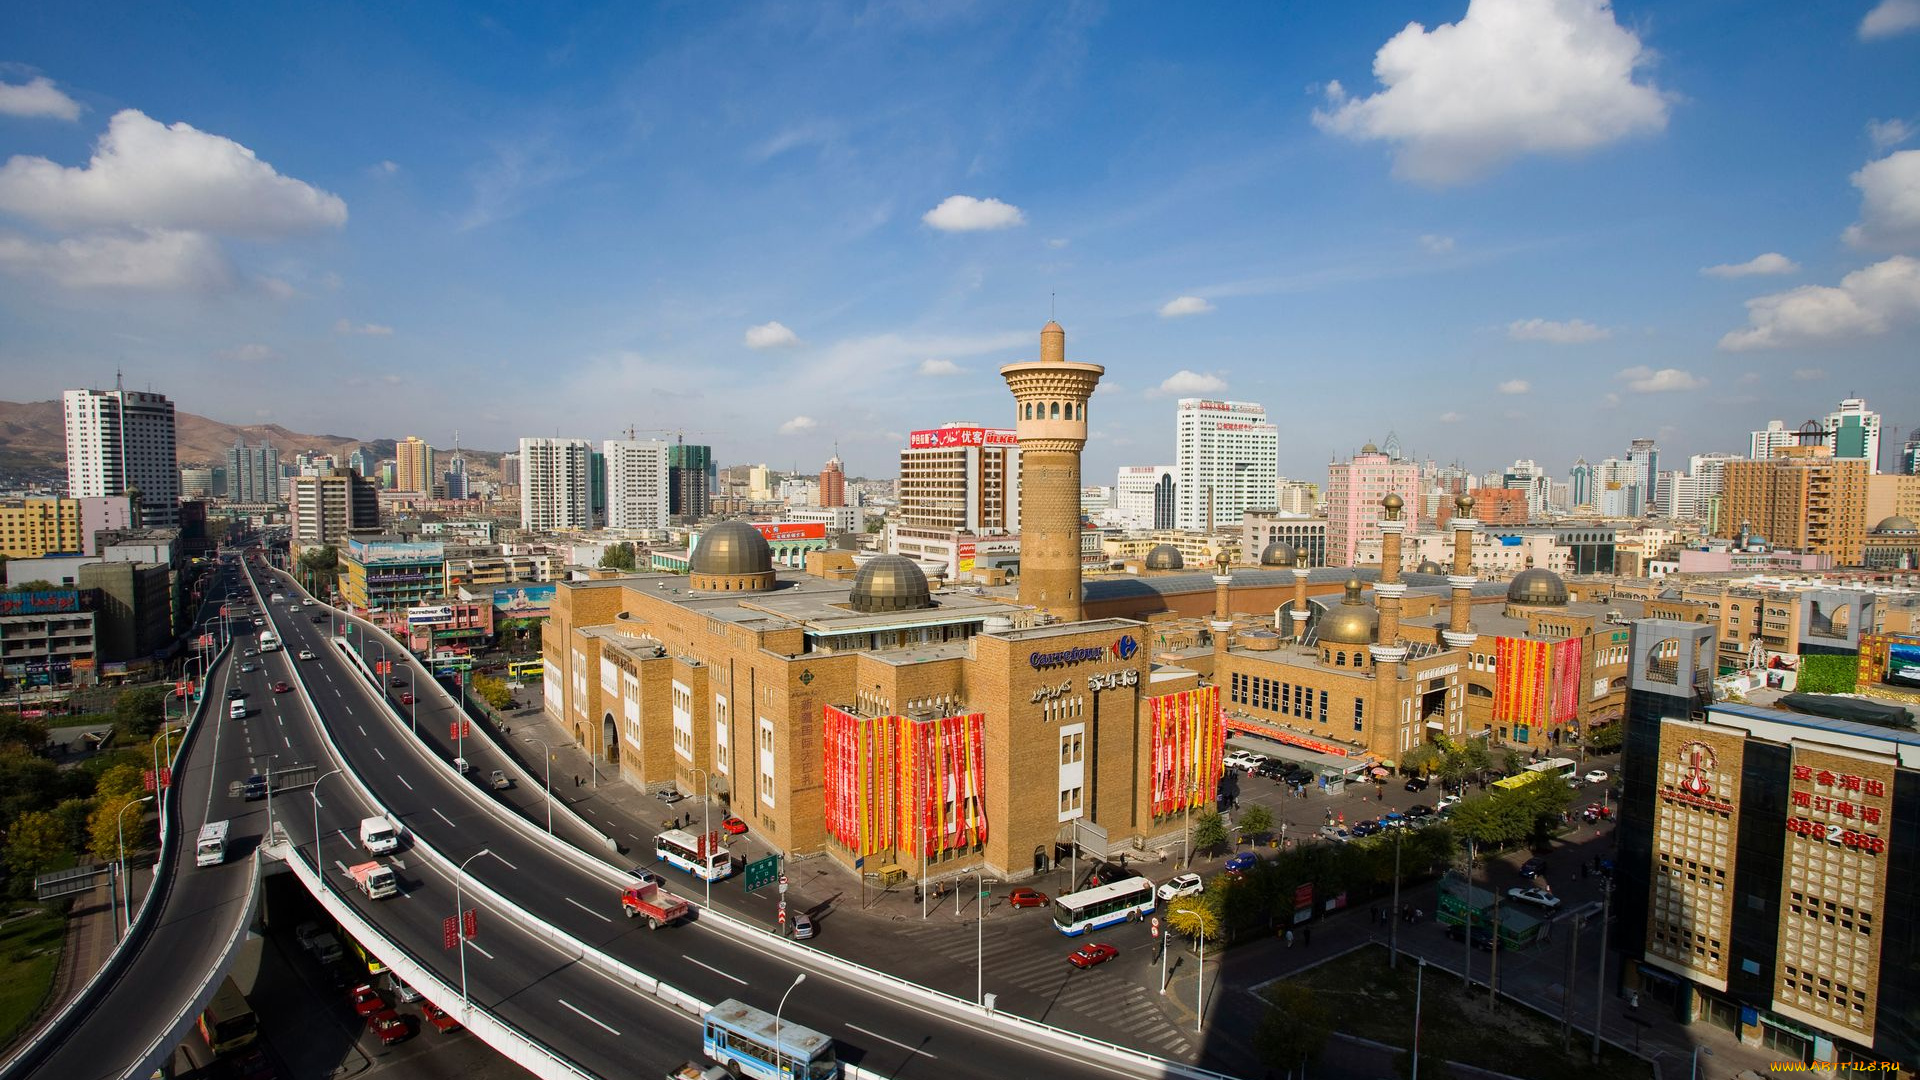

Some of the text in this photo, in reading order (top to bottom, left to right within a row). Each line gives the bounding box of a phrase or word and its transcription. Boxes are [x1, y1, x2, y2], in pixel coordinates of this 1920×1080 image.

[961, 430, 983, 444] 优客
[1029, 646, 1103, 670] Carrefour
[1793, 765, 1885, 797] 宴会演出
[1792, 790, 1883, 825] 预订电话
[1786, 817, 1885, 854] 8882888
